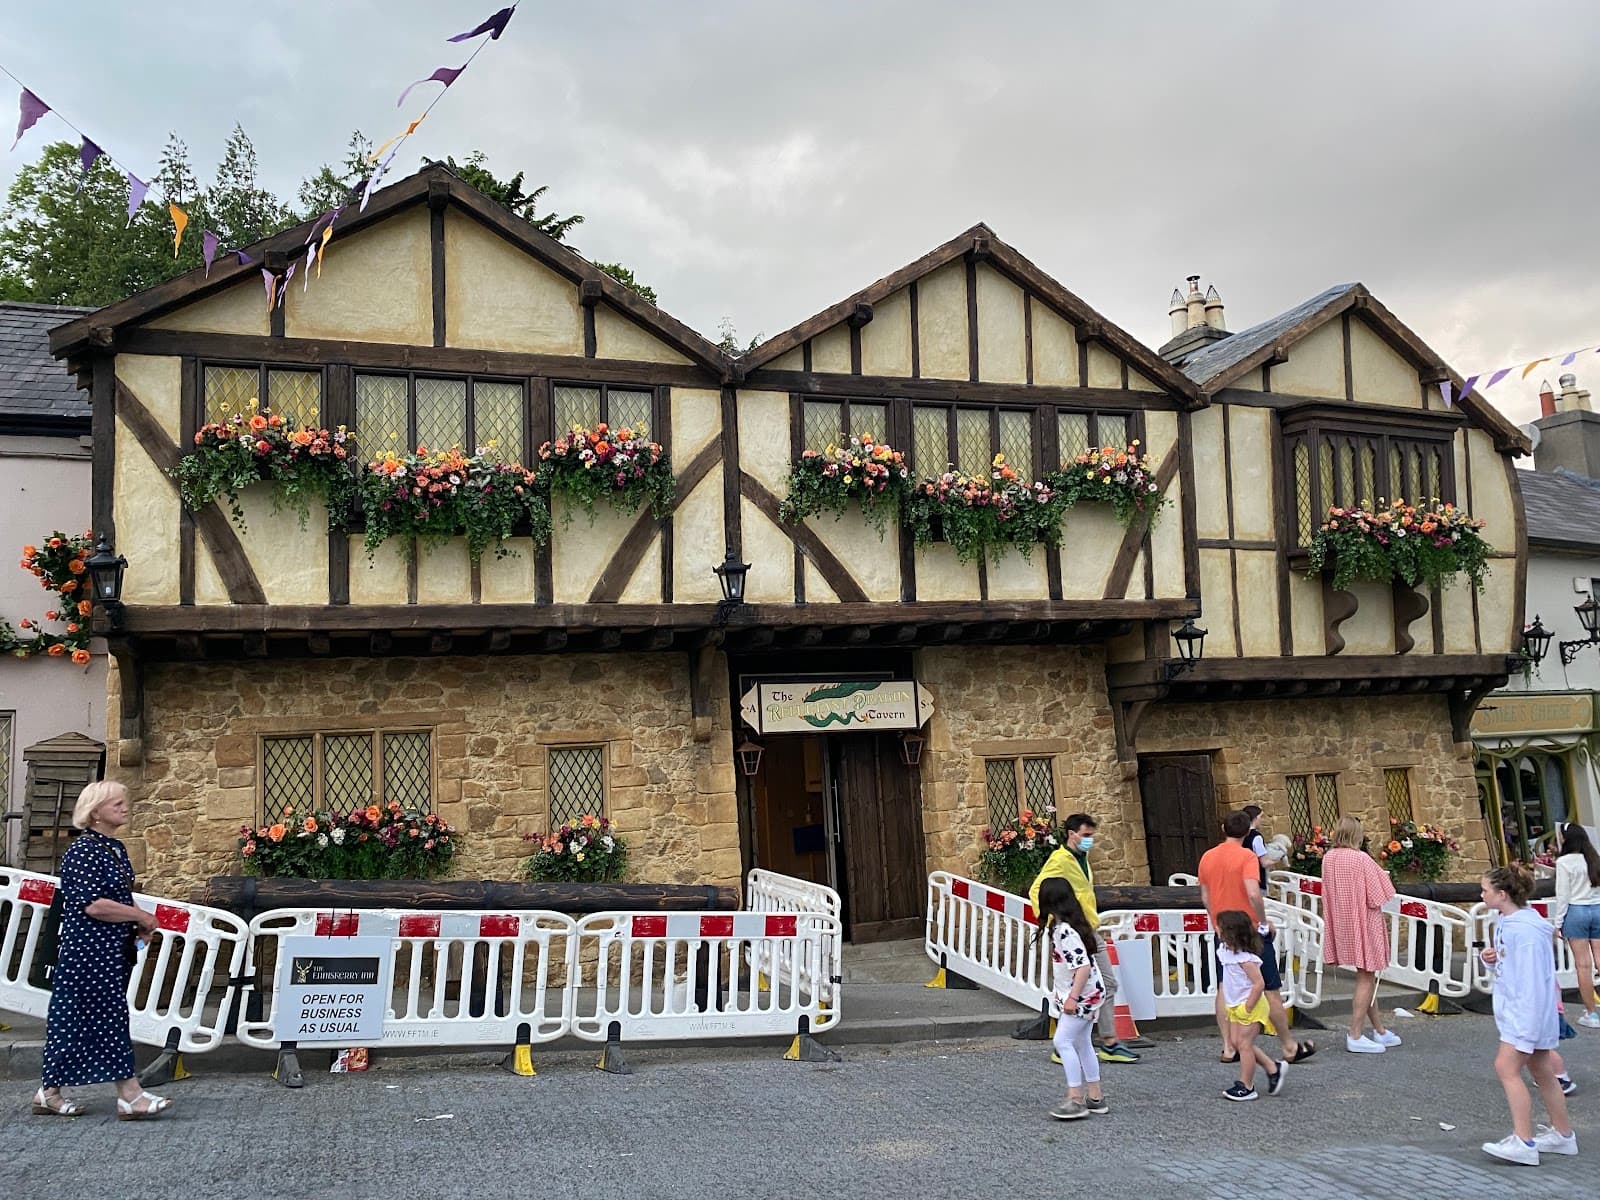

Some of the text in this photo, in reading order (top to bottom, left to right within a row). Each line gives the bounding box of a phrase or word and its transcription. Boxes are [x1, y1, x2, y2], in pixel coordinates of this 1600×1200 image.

[771, 690, 793, 701] The
[867, 709, 906, 720] Tavern
[302, 993, 364, 1005] OPEN FOR
[300, 1008, 362, 1019] BUSINESS
[298, 1021, 360, 1034] AS USUAL
